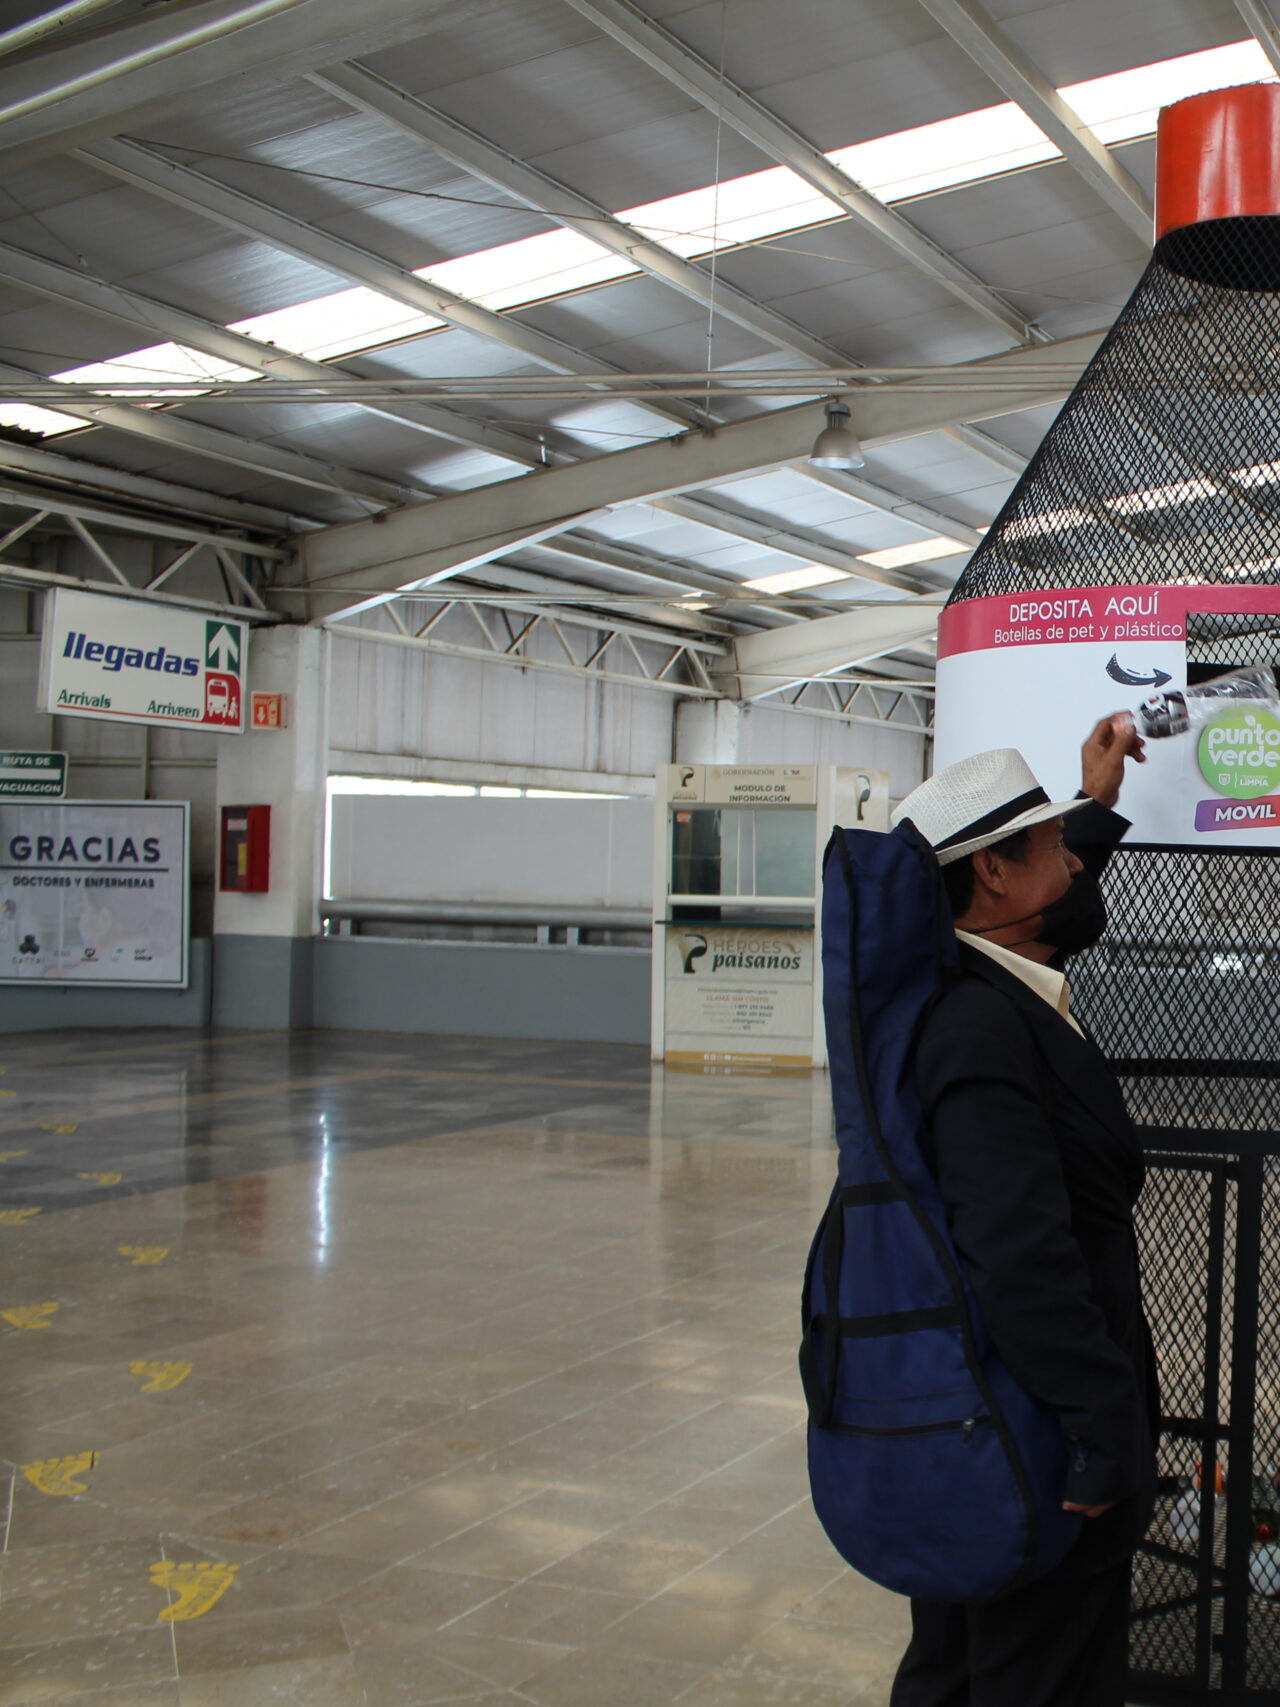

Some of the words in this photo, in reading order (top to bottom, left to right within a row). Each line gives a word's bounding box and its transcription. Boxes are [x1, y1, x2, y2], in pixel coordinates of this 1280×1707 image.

[1009, 598, 1093, 623] DEPOSITA
[1104, 591, 1159, 616] AQUÍ
[994, 627, 1042, 644] Botellas
[1046, 622, 1065, 639] de
[1069, 623, 1095, 641] pet
[1100, 625, 1110, 641] y
[1114, 620, 1183, 641] plástico
[62, 631, 200, 677] llegadas
[57, 689, 111, 708] Arrivals
[147, 700, 200, 718] Arriveen
[2, 756, 32, 766] RUTA
[35, 756, 50, 766] DE
[1208, 745, 1280, 768] verde
[729, 794, 791, 802] INFORMACIÓN
[774, 784, 786, 792] DE
[1215, 804, 1276, 822] MOVIL
[9, 835, 161, 864] GRACIAS
[12, 876, 71, 887] DOCTORES
[75, 877, 81, 887] Y
[84, 877, 155, 888] ENFERMERAS
[712, 952, 801, 972] paisanos
